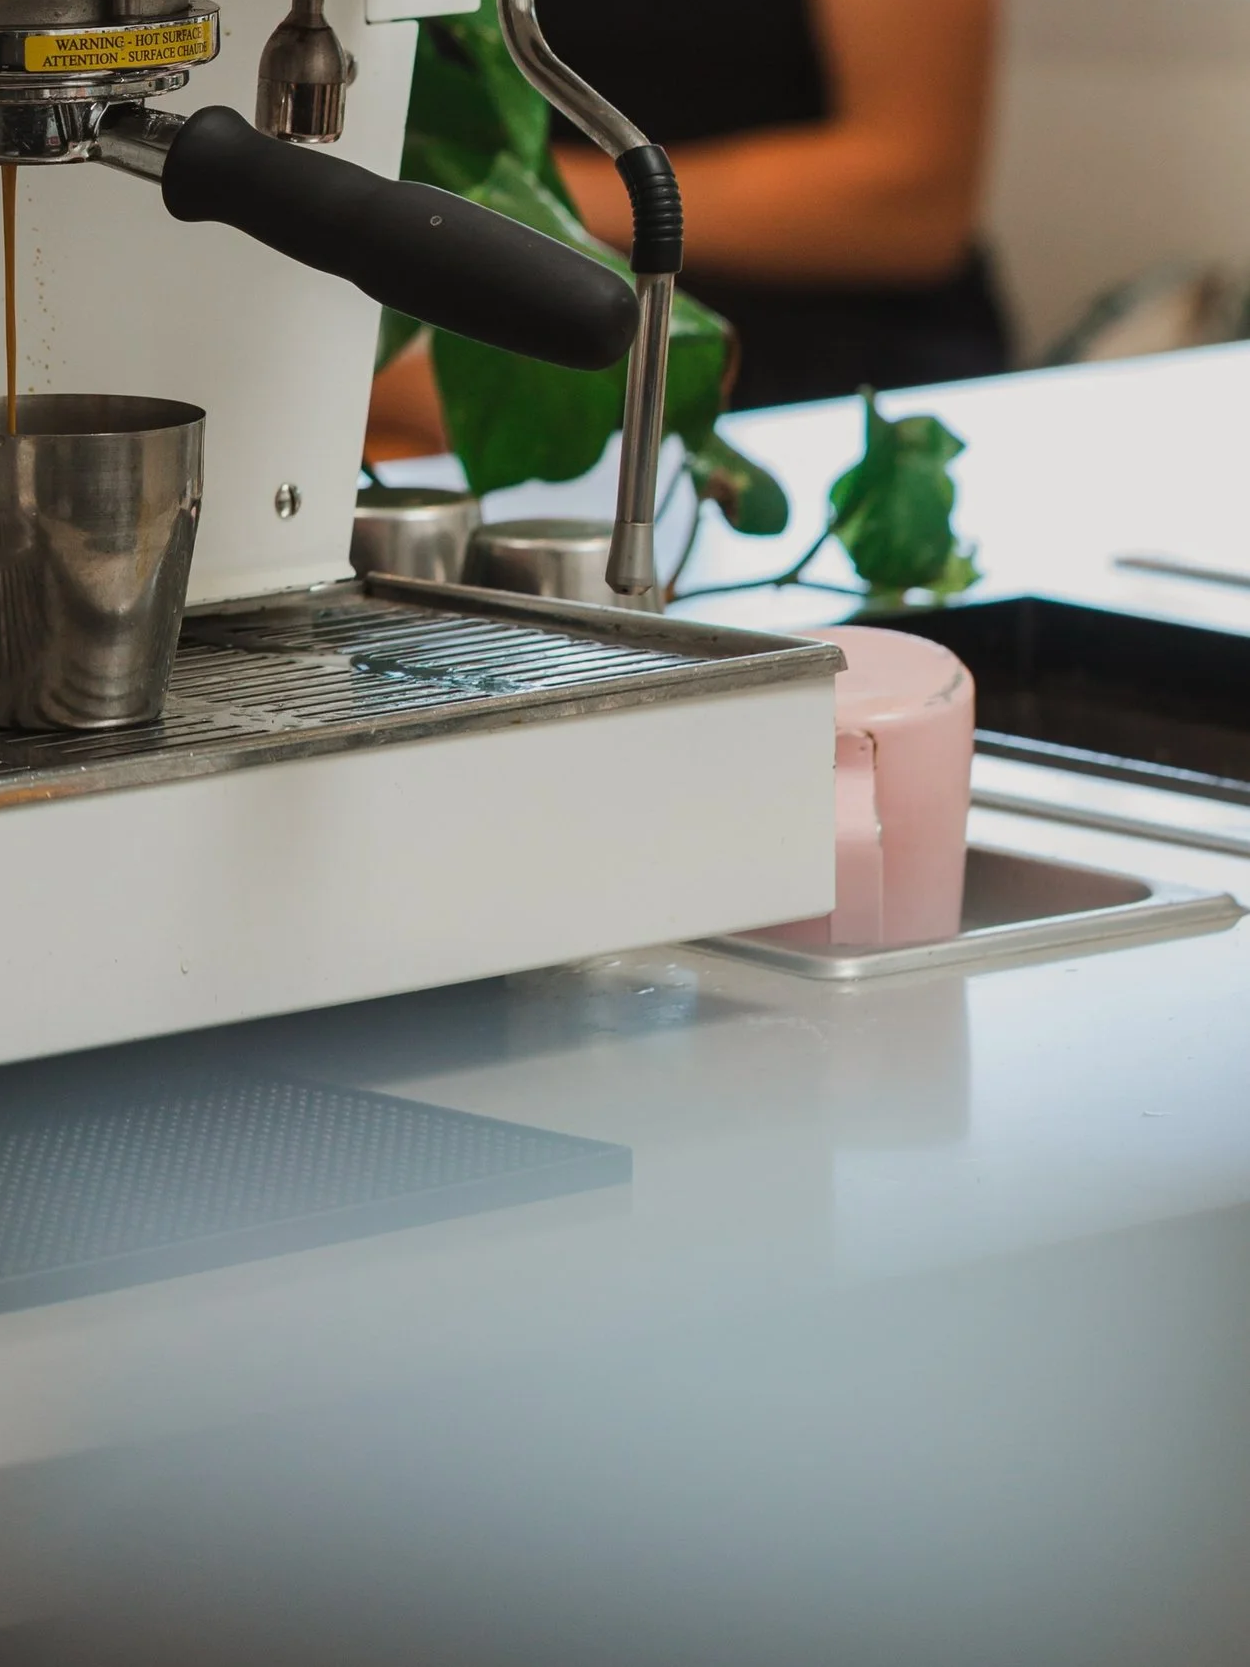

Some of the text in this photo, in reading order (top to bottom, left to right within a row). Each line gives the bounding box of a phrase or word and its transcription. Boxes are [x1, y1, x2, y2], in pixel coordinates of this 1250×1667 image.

[55, 36, 125, 51] WARNING
[135, 32, 160, 47] HOT
[162, 26, 202, 44] SURFACE
[42, 52, 118, 67] ATTENTION
[128, 46, 175, 62] SURFACE
[177, 41, 207, 57] CHAUDE
